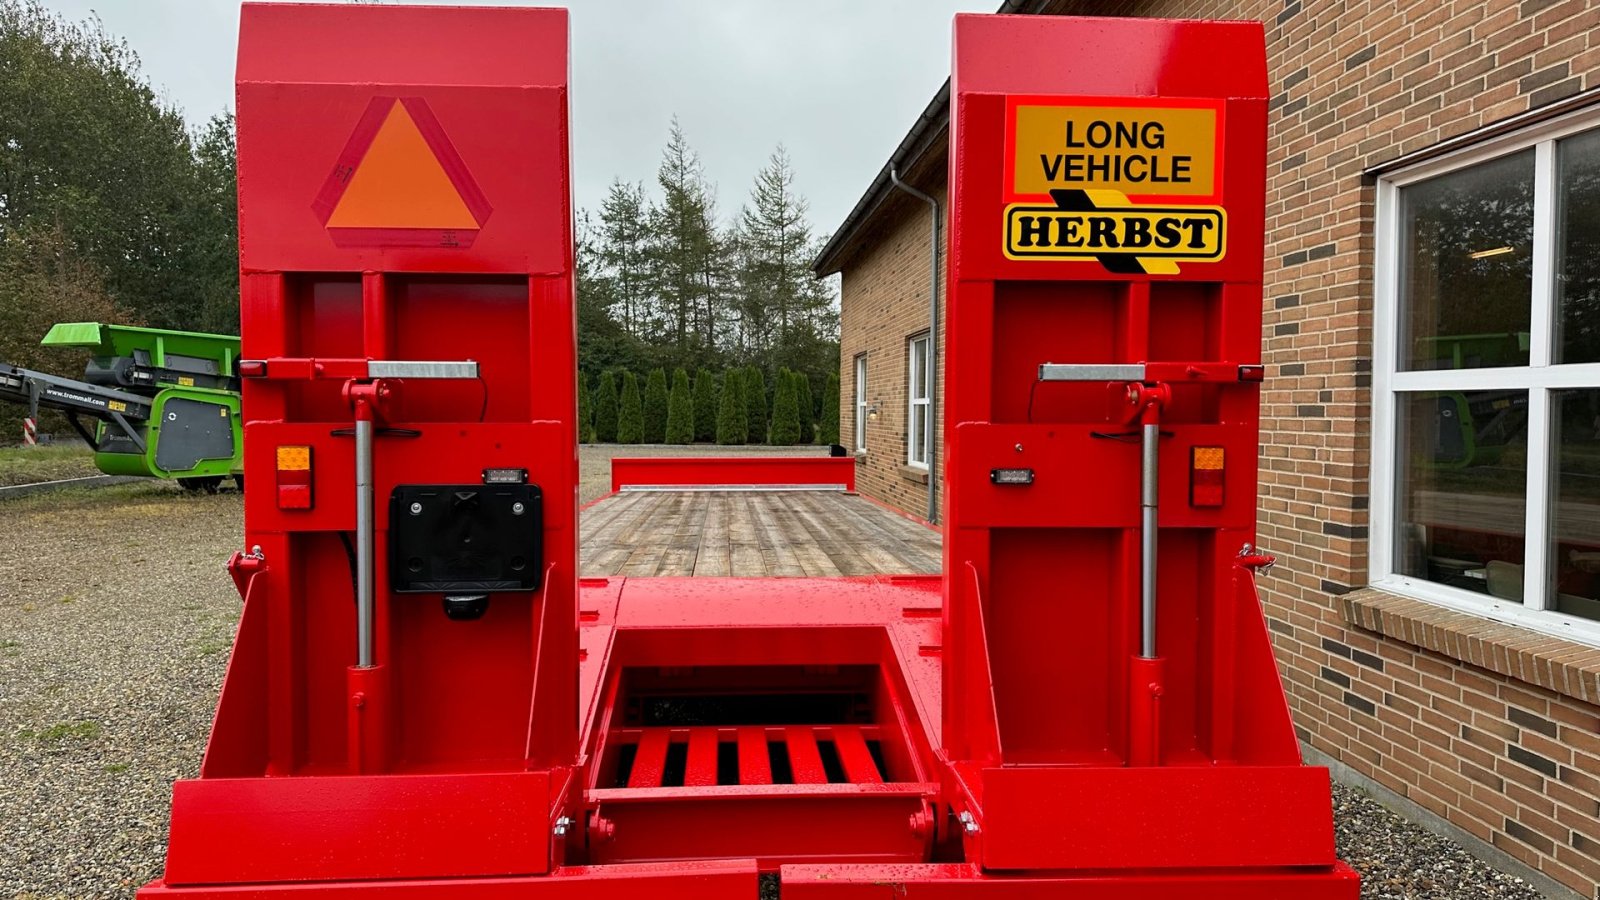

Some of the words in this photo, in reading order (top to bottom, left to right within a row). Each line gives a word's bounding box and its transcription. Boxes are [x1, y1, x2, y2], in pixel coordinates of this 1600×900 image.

[1066, 120, 1165, 149] LONG
[1040, 154, 1192, 183] VEHICLE
[1017, 216, 1214, 249] HERBST
[46, 389, 105, 406] www.trommall.com
